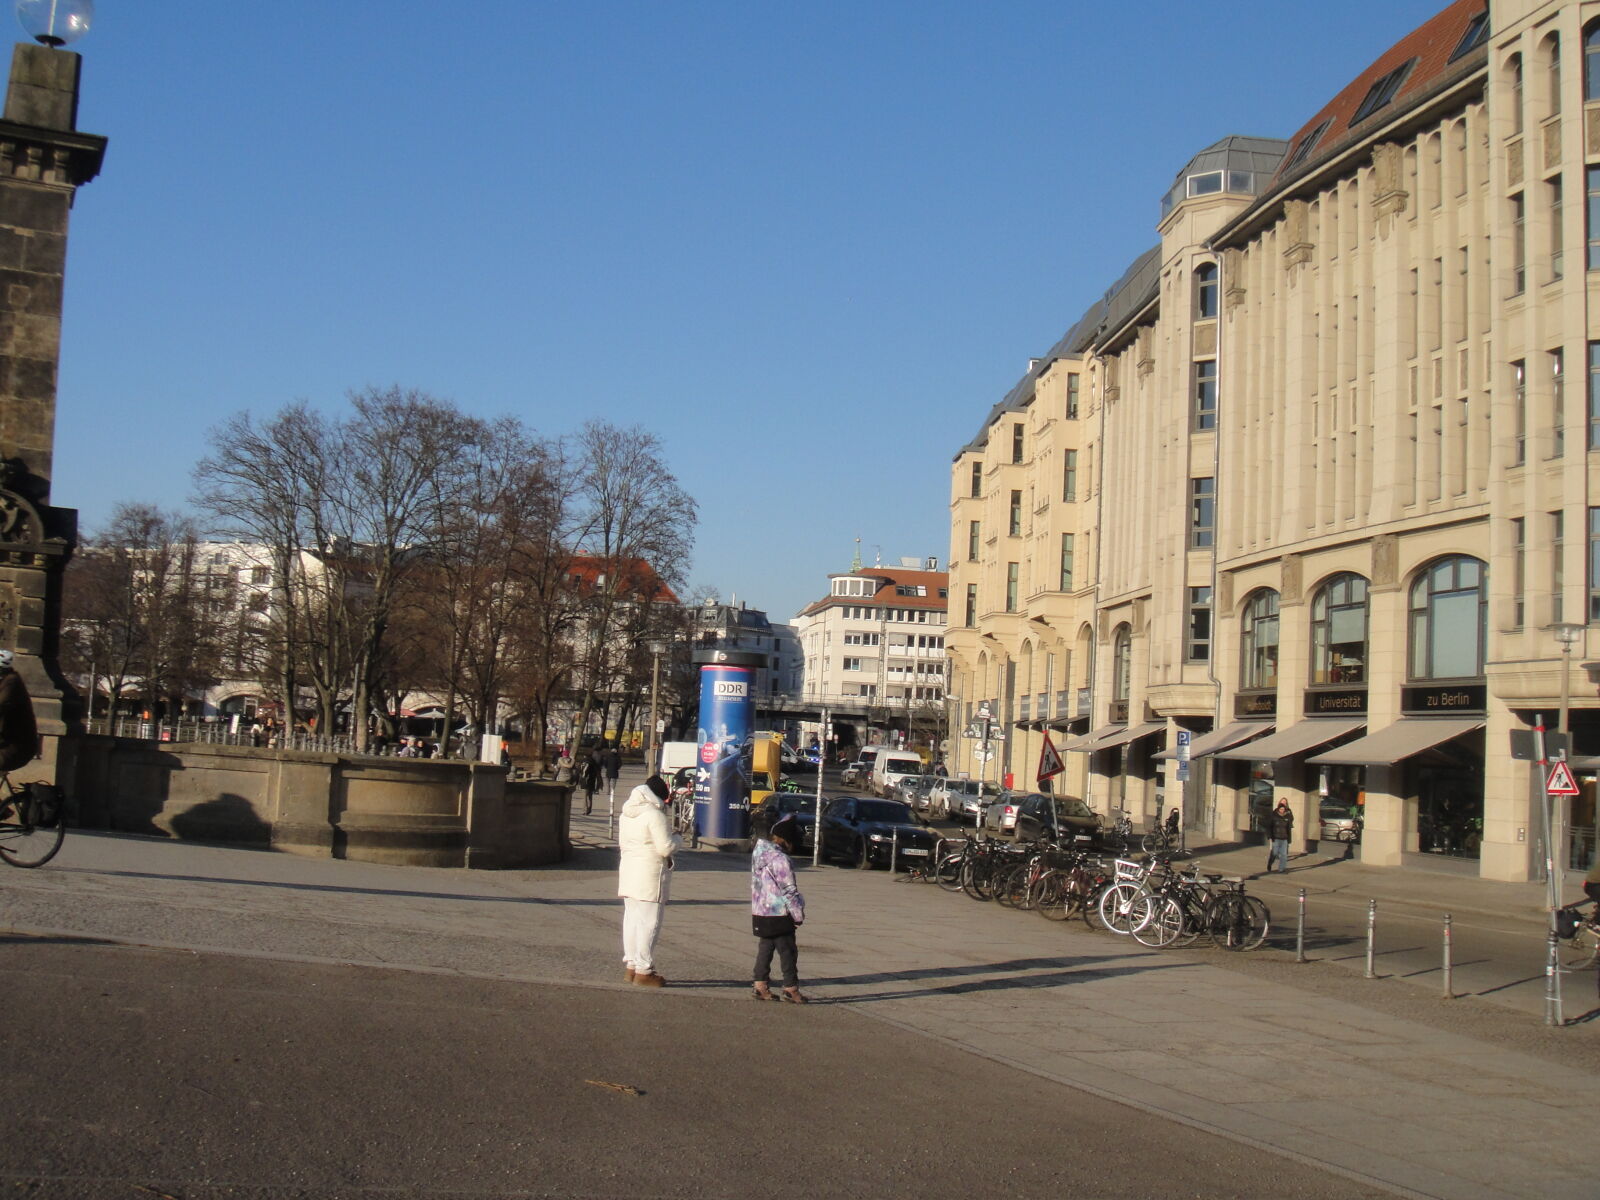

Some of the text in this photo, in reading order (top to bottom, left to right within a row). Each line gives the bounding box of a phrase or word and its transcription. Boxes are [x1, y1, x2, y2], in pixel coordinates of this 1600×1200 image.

[718, 683, 743, 694] DDR
[1319, 695, 1361, 709] Universität
[1427, 692, 1469, 706] zu Berlin
[1179, 732, 1187, 745] P
